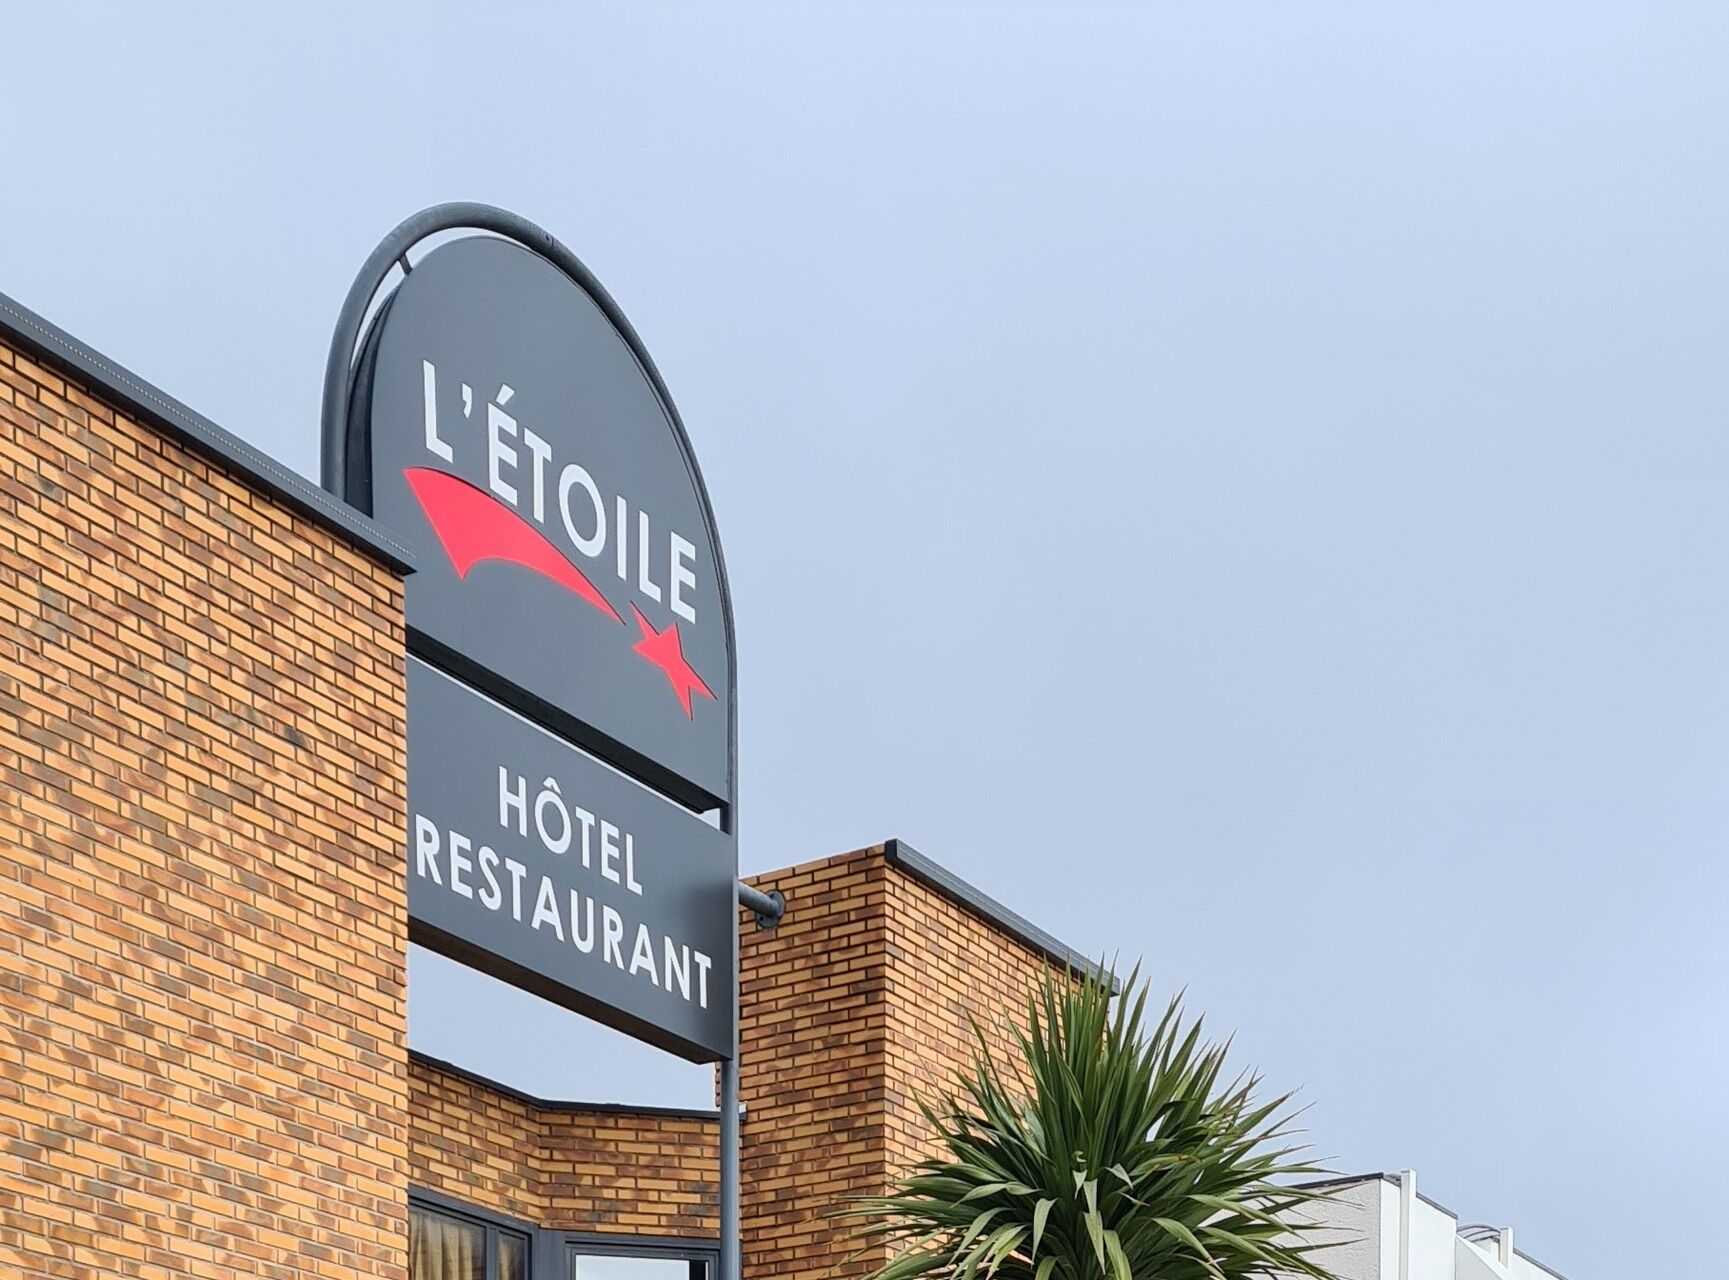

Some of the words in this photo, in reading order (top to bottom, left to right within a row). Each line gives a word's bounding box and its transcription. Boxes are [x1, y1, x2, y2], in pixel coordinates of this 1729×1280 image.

[423, 359, 696, 623] L'ÉTOILE
[415, 814, 712, 1008] RESTAURANT
[498, 766, 643, 896] HÔTEL
